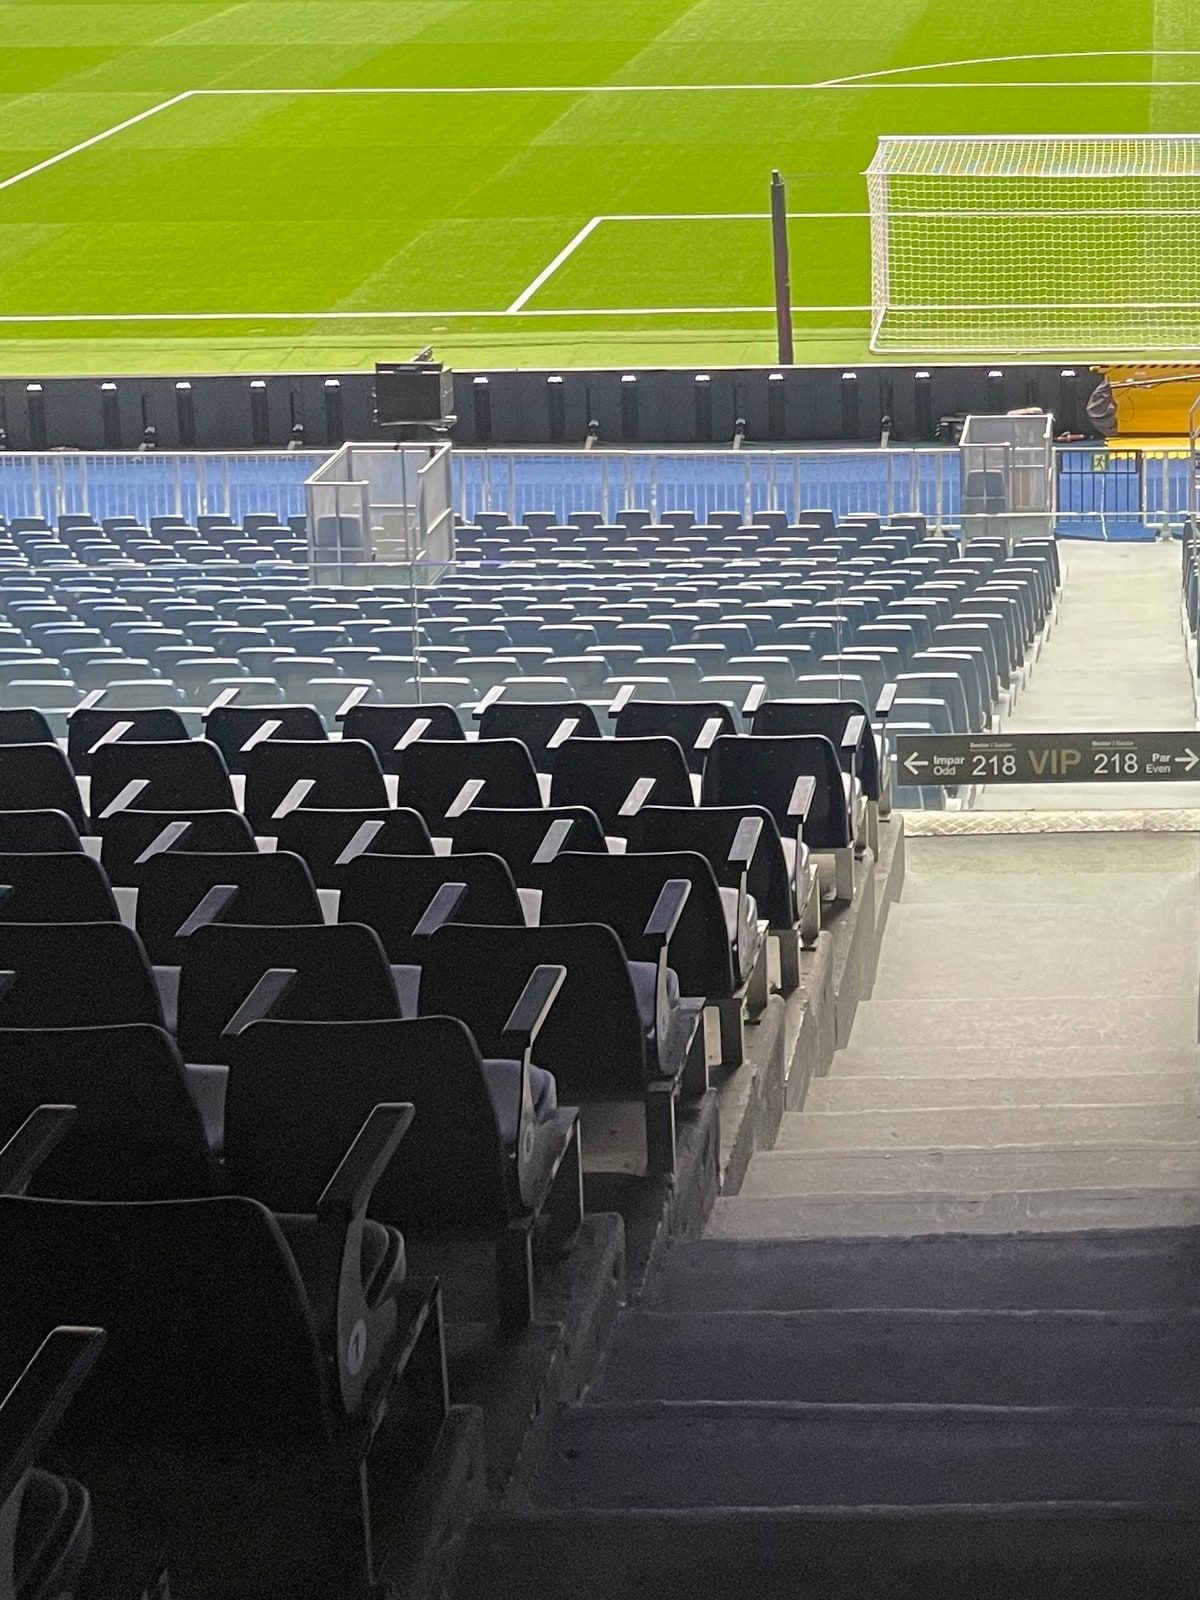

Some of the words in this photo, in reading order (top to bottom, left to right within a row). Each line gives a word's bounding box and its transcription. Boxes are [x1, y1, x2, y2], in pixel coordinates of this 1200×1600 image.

[933, 756, 965, 768] Impar
[971, 755, 1017, 776] 218
[1027, 749, 1082, 775] VIP
[1093, 753, 1138, 774] 218
[1152, 753, 1171, 763] Par
[933, 766, 956, 776] Odd
[1146, 764, 1171, 774] Even
